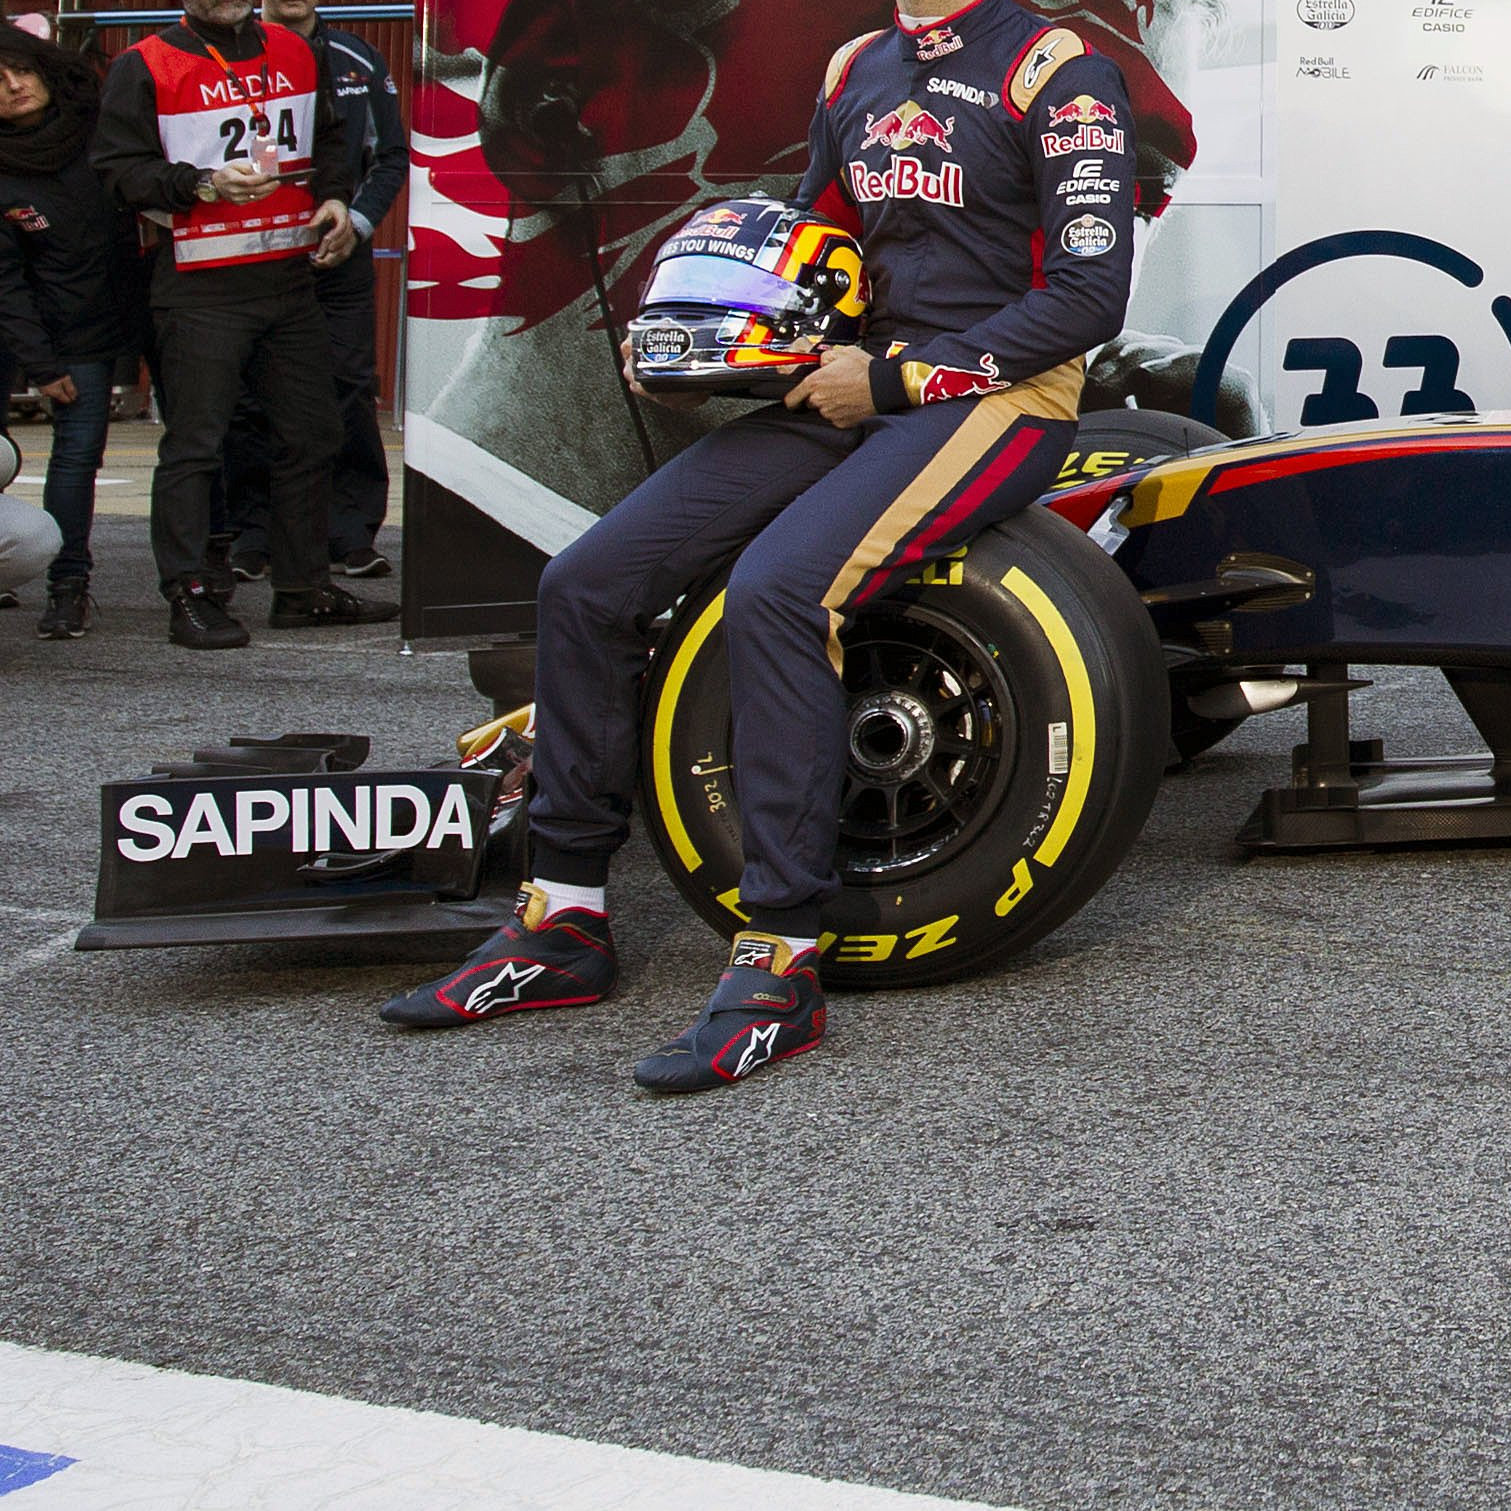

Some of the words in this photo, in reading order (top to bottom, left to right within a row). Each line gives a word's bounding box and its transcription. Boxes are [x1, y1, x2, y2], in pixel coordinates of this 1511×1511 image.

[1307, 10, 1346, 21] Galicia
[1411, 7, 1476, 19] EDIFICE
[1422, 22, 1466, 33] CASIO
[1443, 64, 1484, 76] FALCON
[199, 71, 295, 106] MEDIA
[926, 77, 985, 106] SAPINDA
[1041, 126, 1085, 158] Red
[1084, 125, 1125, 156] Bull
[849, 158, 896, 203] Red
[893, 154, 964, 208] Bull
[1056, 178, 1120, 195] EDIFICE
[1066, 194, 1111, 206] CASIO
[701, 224, 741, 240] Bull
[1068, 226, 1109, 239] Estrella
[1069, 236, 1107, 248] Galicia
[680, 239, 706, 252] YOU
[707, 240, 756, 261] WINGS
[646, 331, 685, 343] Estrella
[647, 343, 682, 354] Galicia
[117, 783, 474, 862] SAPINDA
